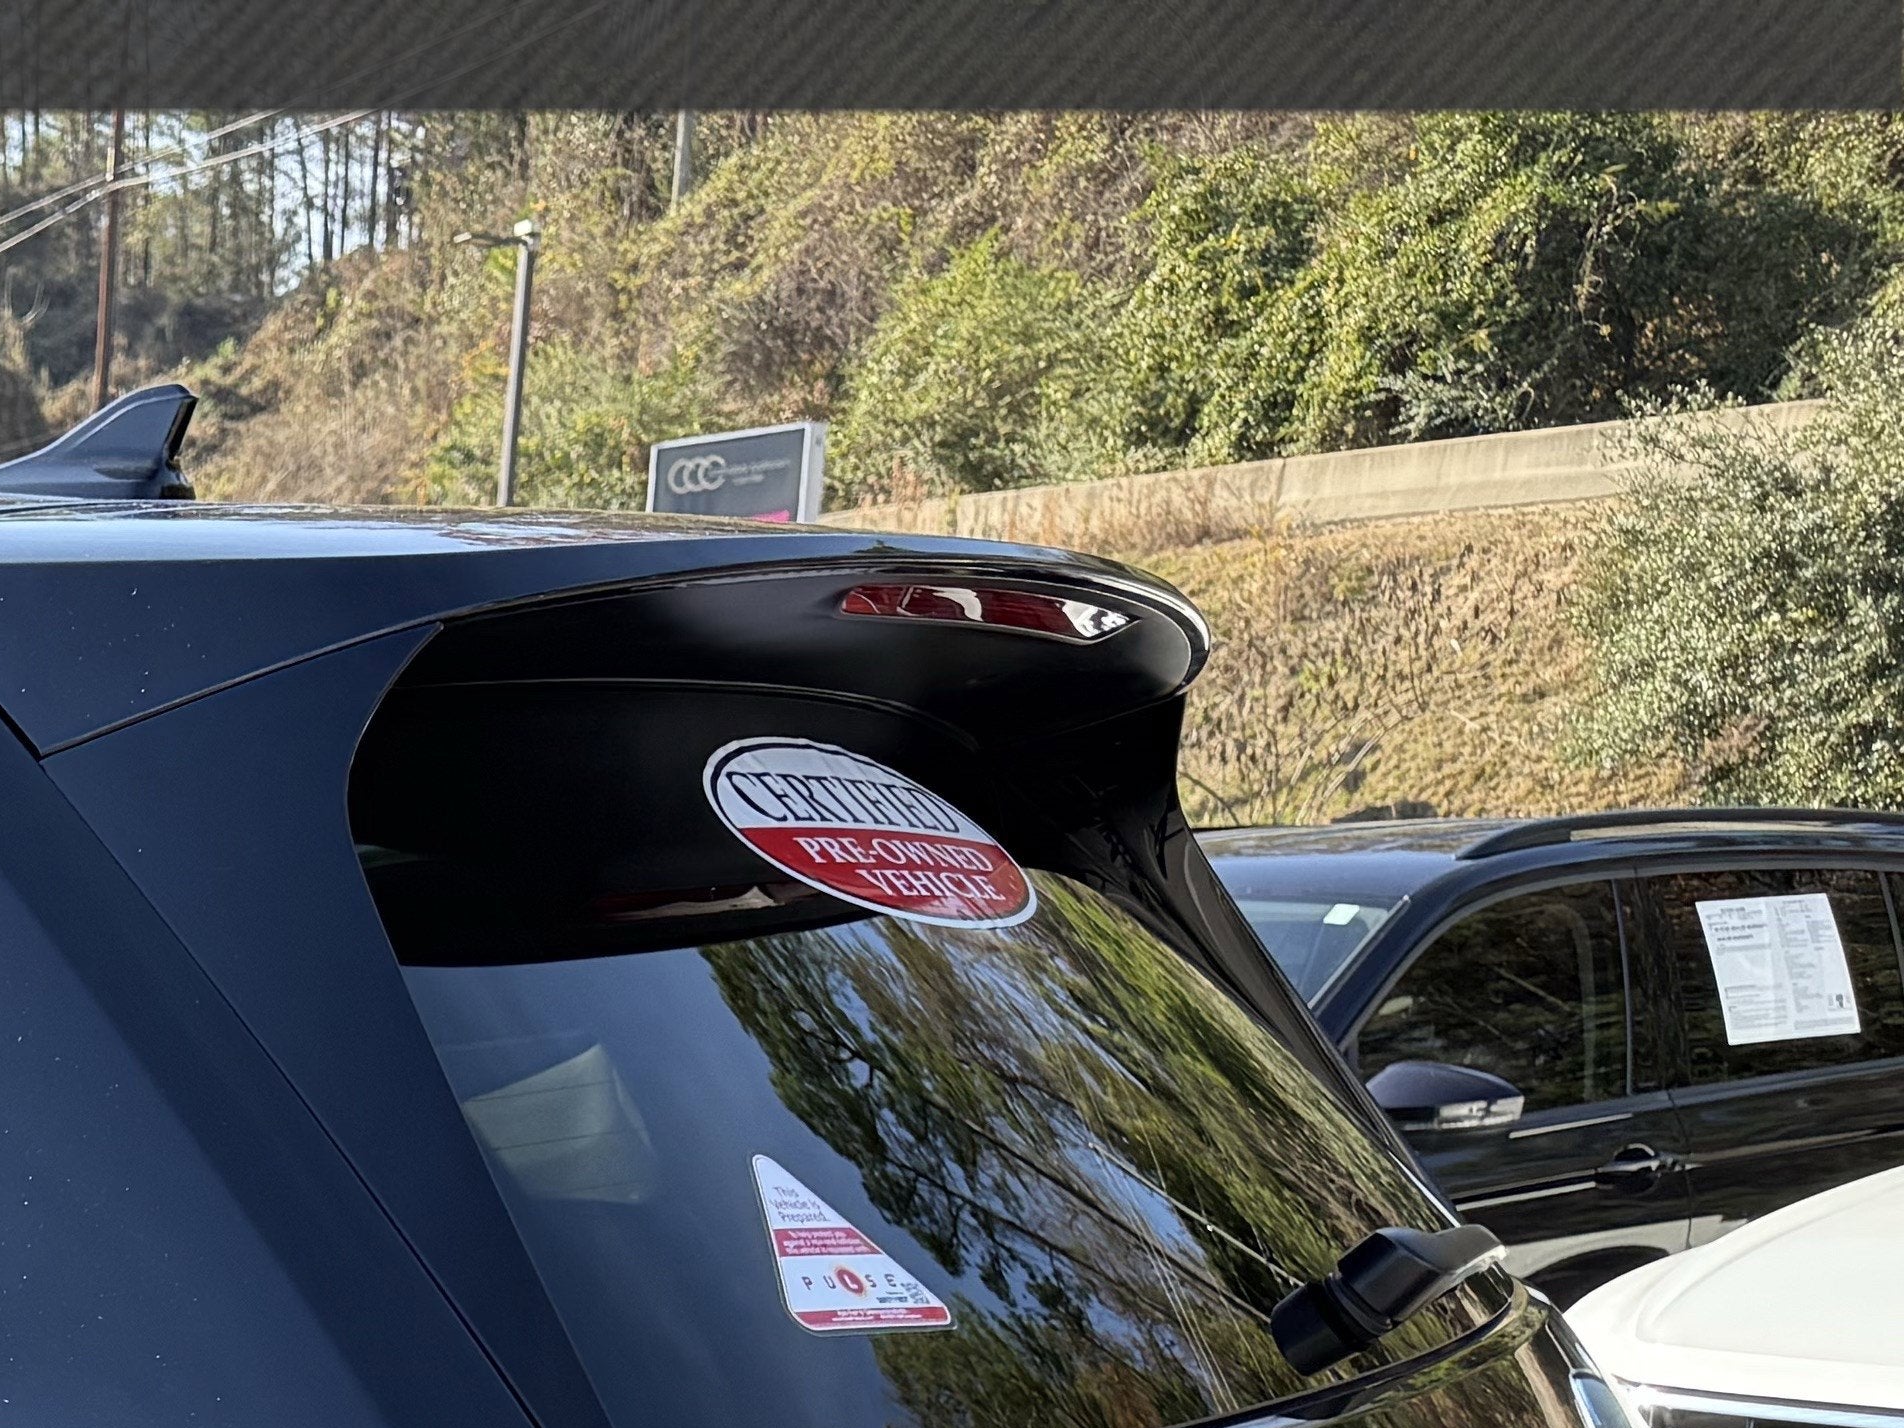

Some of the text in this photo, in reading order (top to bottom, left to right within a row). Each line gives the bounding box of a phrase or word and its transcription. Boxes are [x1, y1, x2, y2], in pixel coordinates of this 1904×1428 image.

[725, 771, 960, 834] CERTIFIED
[793, 837, 993, 872] PRE-OWNED
[855, 869, 1006, 901] VEHICLE
